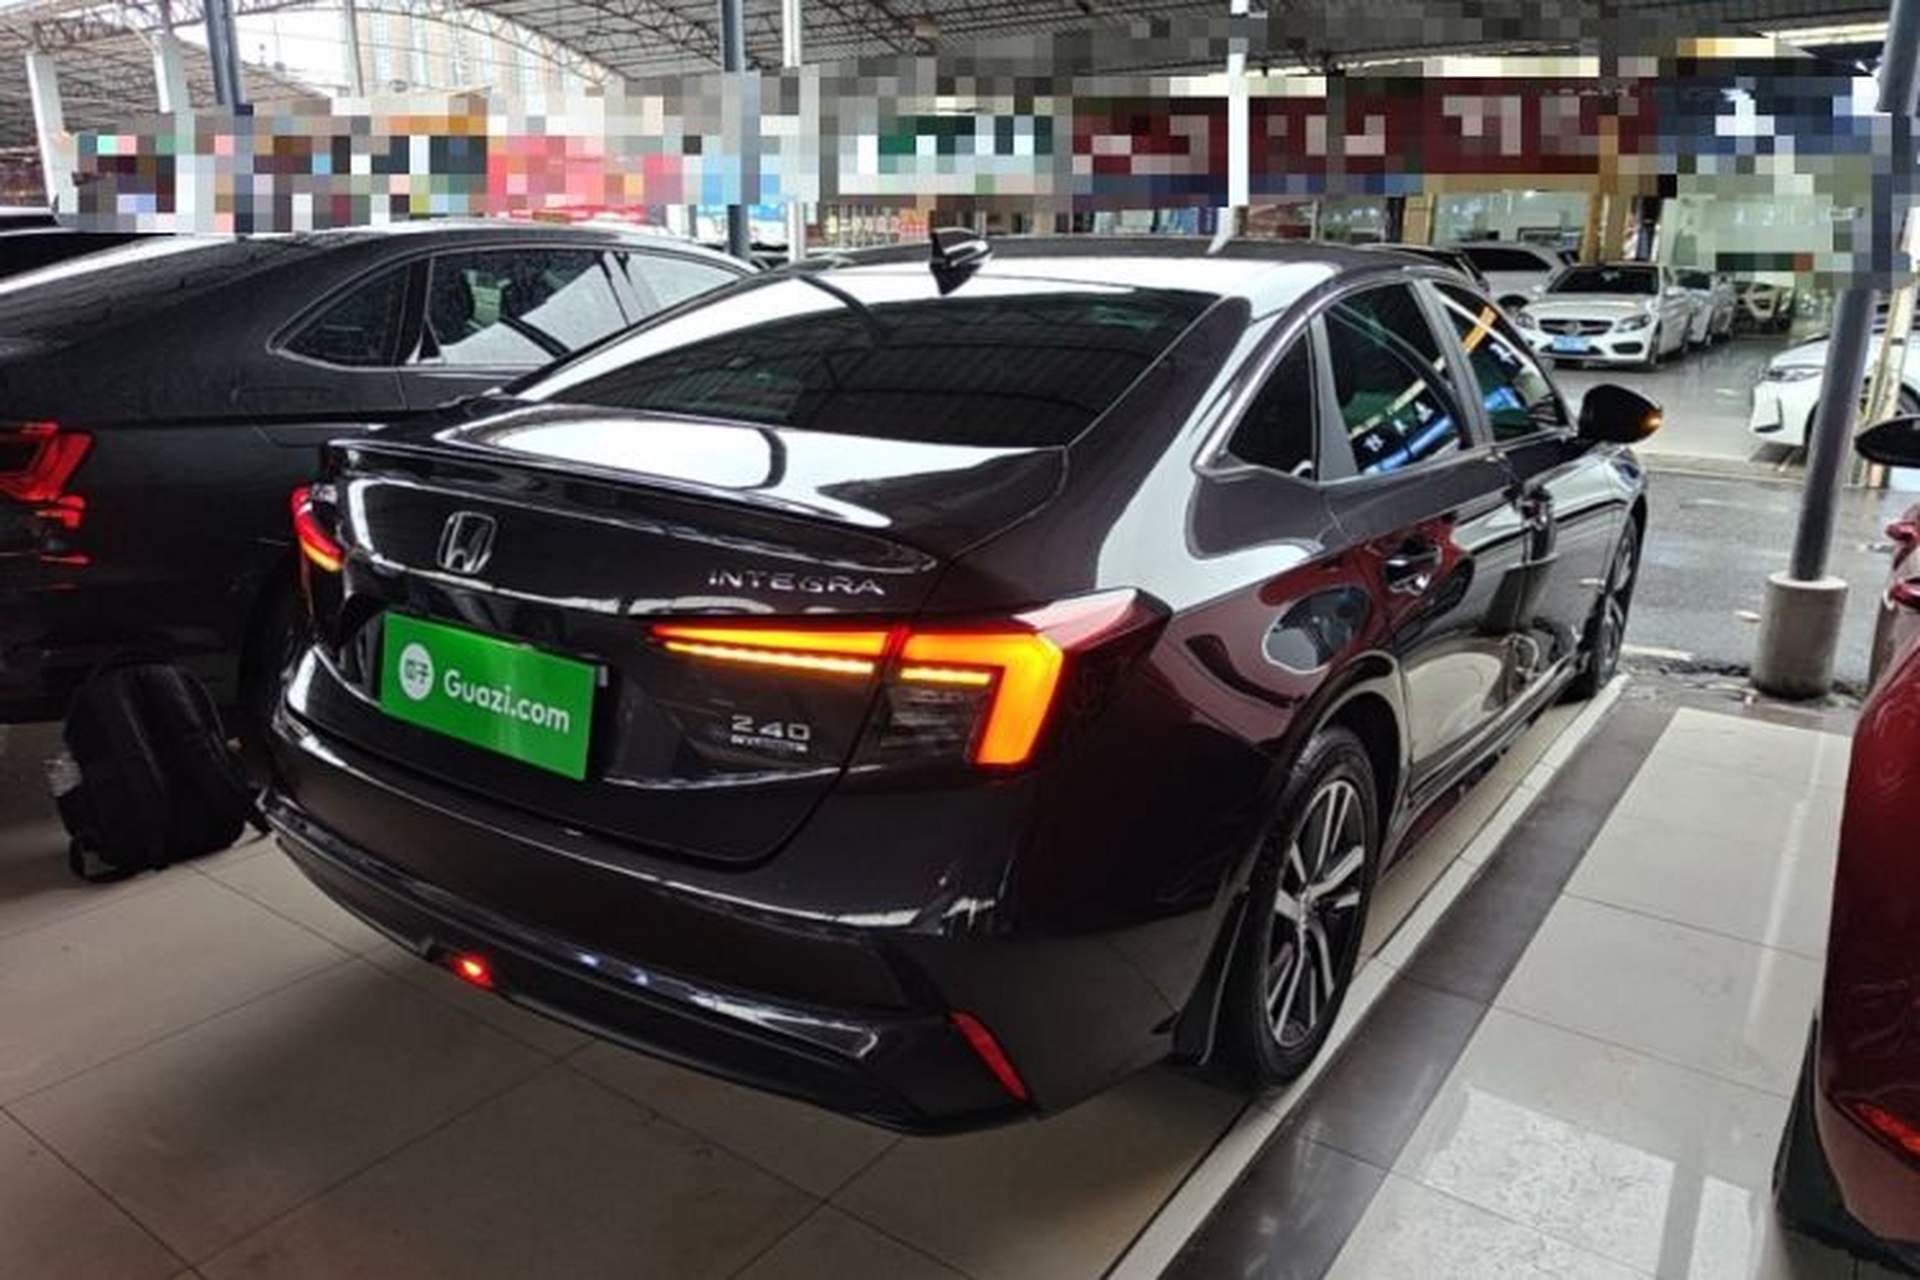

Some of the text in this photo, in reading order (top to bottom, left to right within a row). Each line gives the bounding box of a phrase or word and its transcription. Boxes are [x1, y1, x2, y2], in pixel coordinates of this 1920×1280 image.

[708, 569, 886, 596] INTEGRA
[443, 668, 570, 734] Guazi.com
[731, 714, 811, 741] 240
